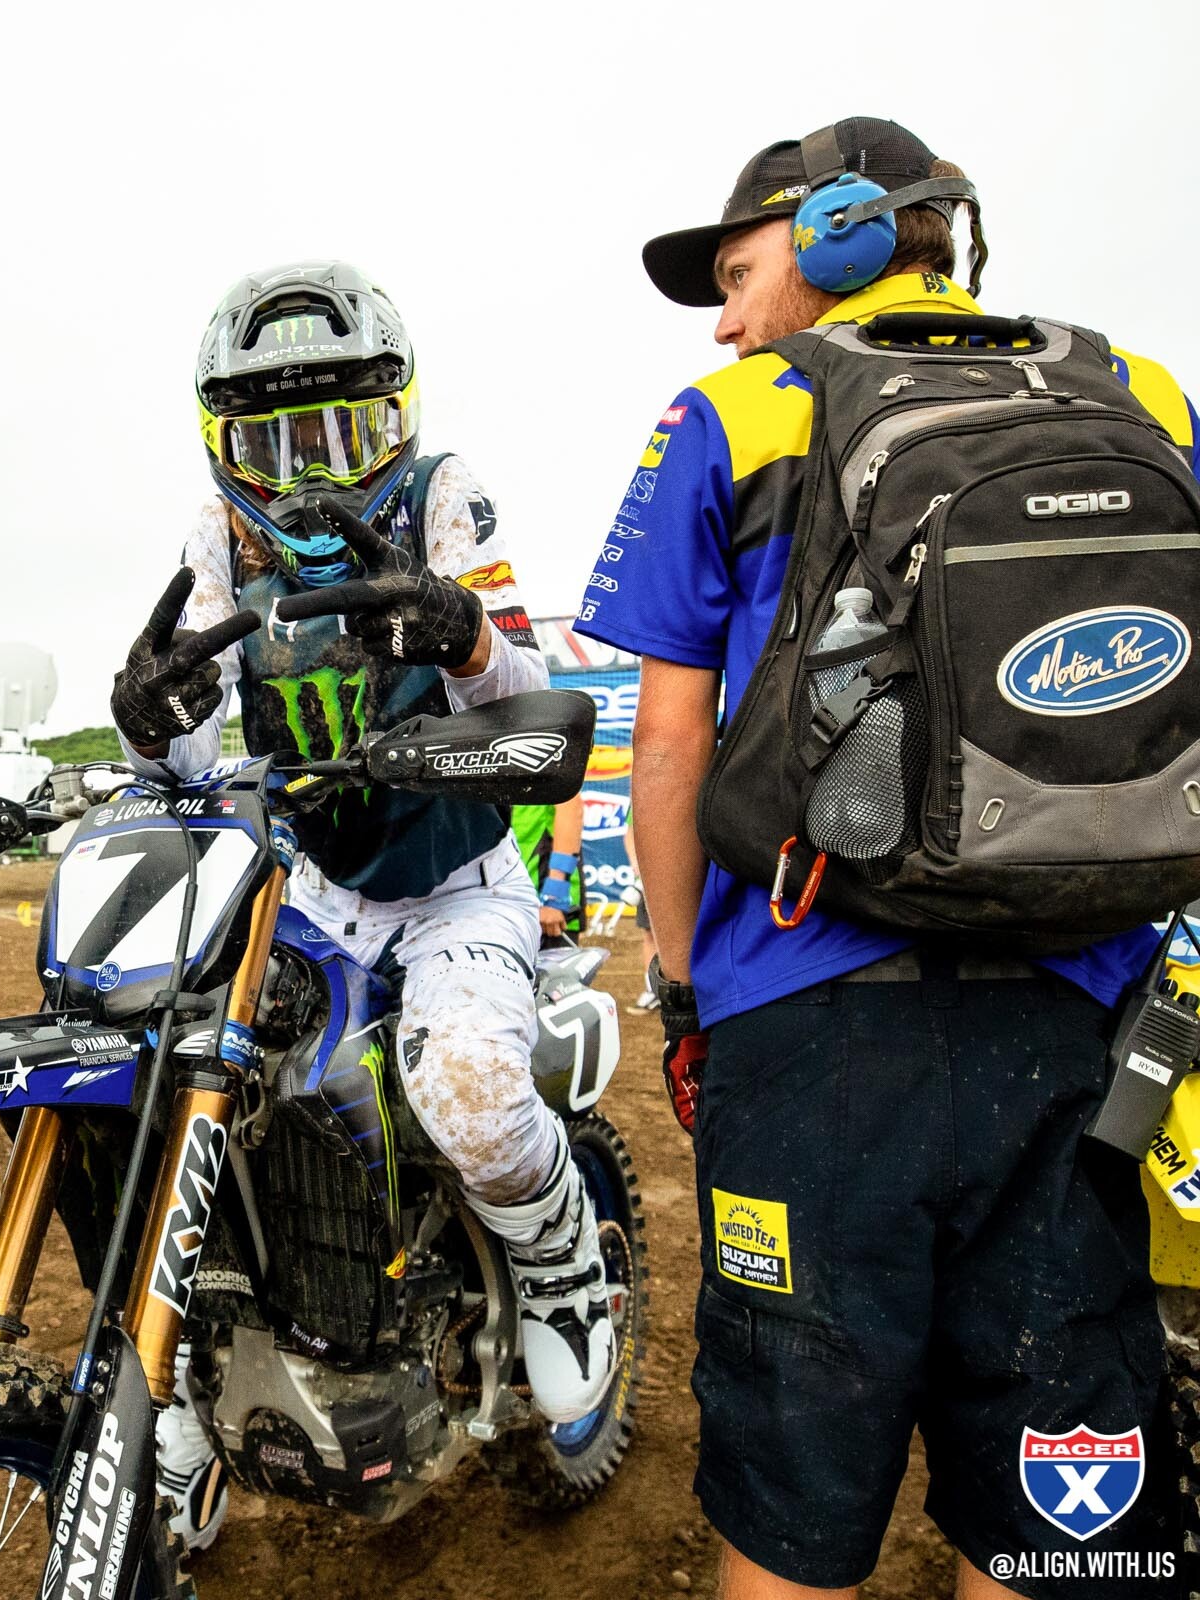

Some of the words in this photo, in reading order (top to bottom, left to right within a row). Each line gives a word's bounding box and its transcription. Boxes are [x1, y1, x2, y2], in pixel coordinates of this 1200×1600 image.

[266, 382, 278, 392] ONE
[300, 377, 313, 386] ONE
[1026, 490, 1131, 515] OGIO
[391, 616, 404, 658] THOR
[1027, 637, 1113, 694] Motion
[1108, 626, 1165, 669] Pro
[168, 695, 196, 730] THOR
[434, 752, 508, 769] CYCRA
[442, 768, 480, 776] STEALTH
[114, 800, 168, 822] LUCAS
[176, 799, 205, 816] OIL
[65, 831, 221, 968] 7
[1163, 1005, 1198, 1024] MOTOROLA
[83, 1034, 129, 1051] YAMAHA
[550, 1000, 601, 1098] 7
[80, 1055, 108, 1067] FINANCIAL
[109, 1052, 133, 1063] SERVICES
[1138, 1061, 1161, 1076] RYAN
[149, 1113, 227, 1319] KYB
[720, 1222, 753, 1240] TWISTED
[755, 1227, 778, 1251] TEA
[721, 1245, 778, 1272] SUZUKI
[196, 1270, 251, 1284] WORKS
[723, 1261, 742, 1276] THOR
[745, 1270, 777, 1284] MAYHEM
[291, 1322, 311, 1344] Twin
[310, 1337, 329, 1350] Air
[56, 1450, 89, 1546] CYCRA
[101, 1489, 135, 1600] BRAKING
